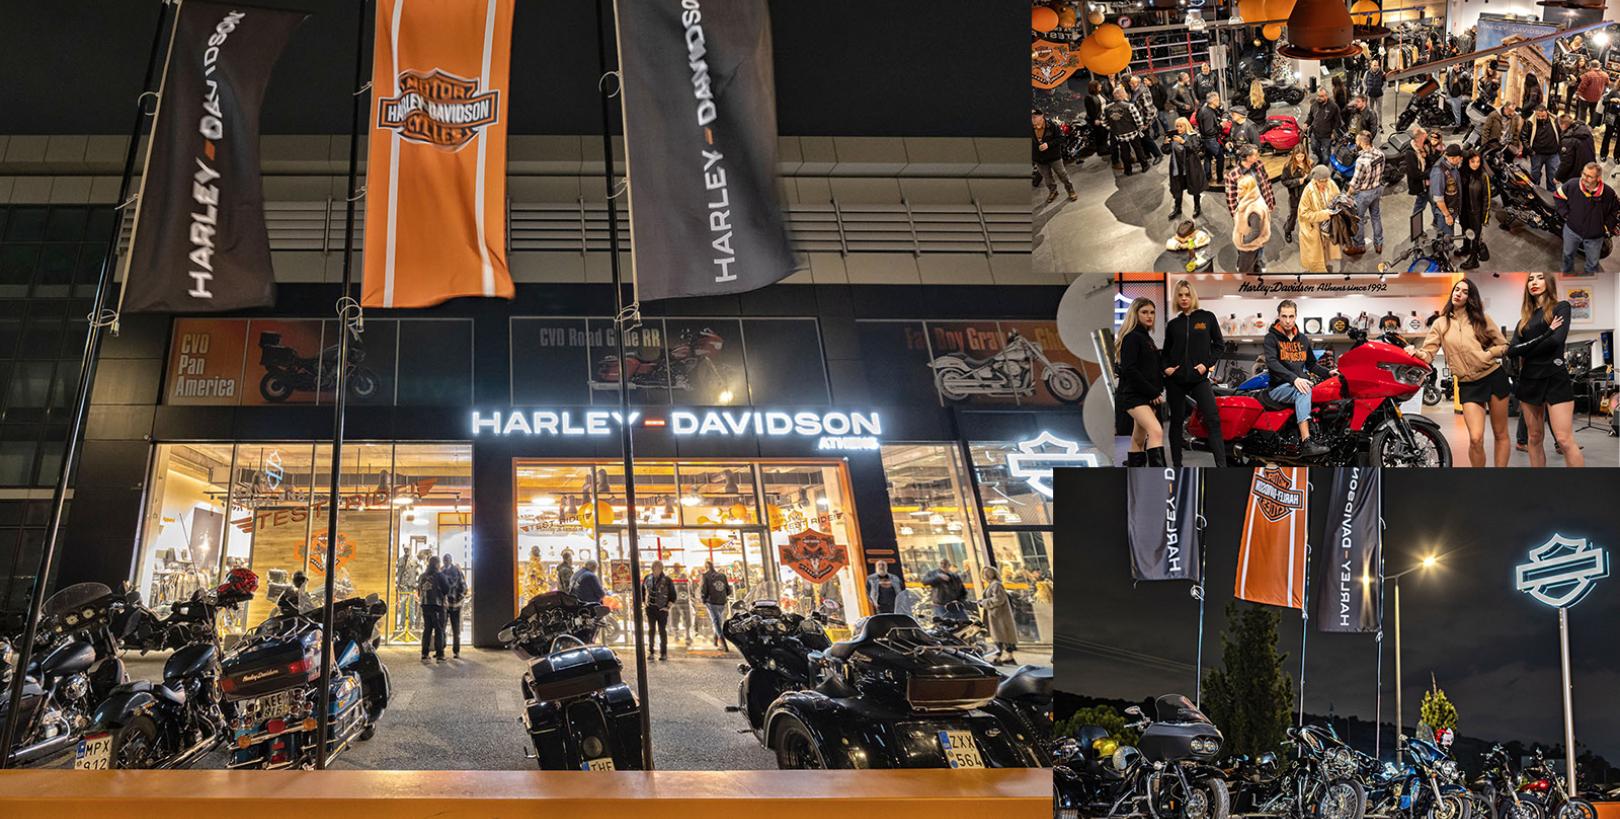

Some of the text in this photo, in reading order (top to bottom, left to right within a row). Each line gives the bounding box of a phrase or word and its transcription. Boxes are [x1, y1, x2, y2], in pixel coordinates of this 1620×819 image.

[181, 334, 209, 354] CVO
[642, 328, 661, 347] RR
[178, 355, 205, 375] Pan
[174, 375, 236, 397] America
[949, 735, 976, 749] ZXX
[956, 753, 983, 767] 564
